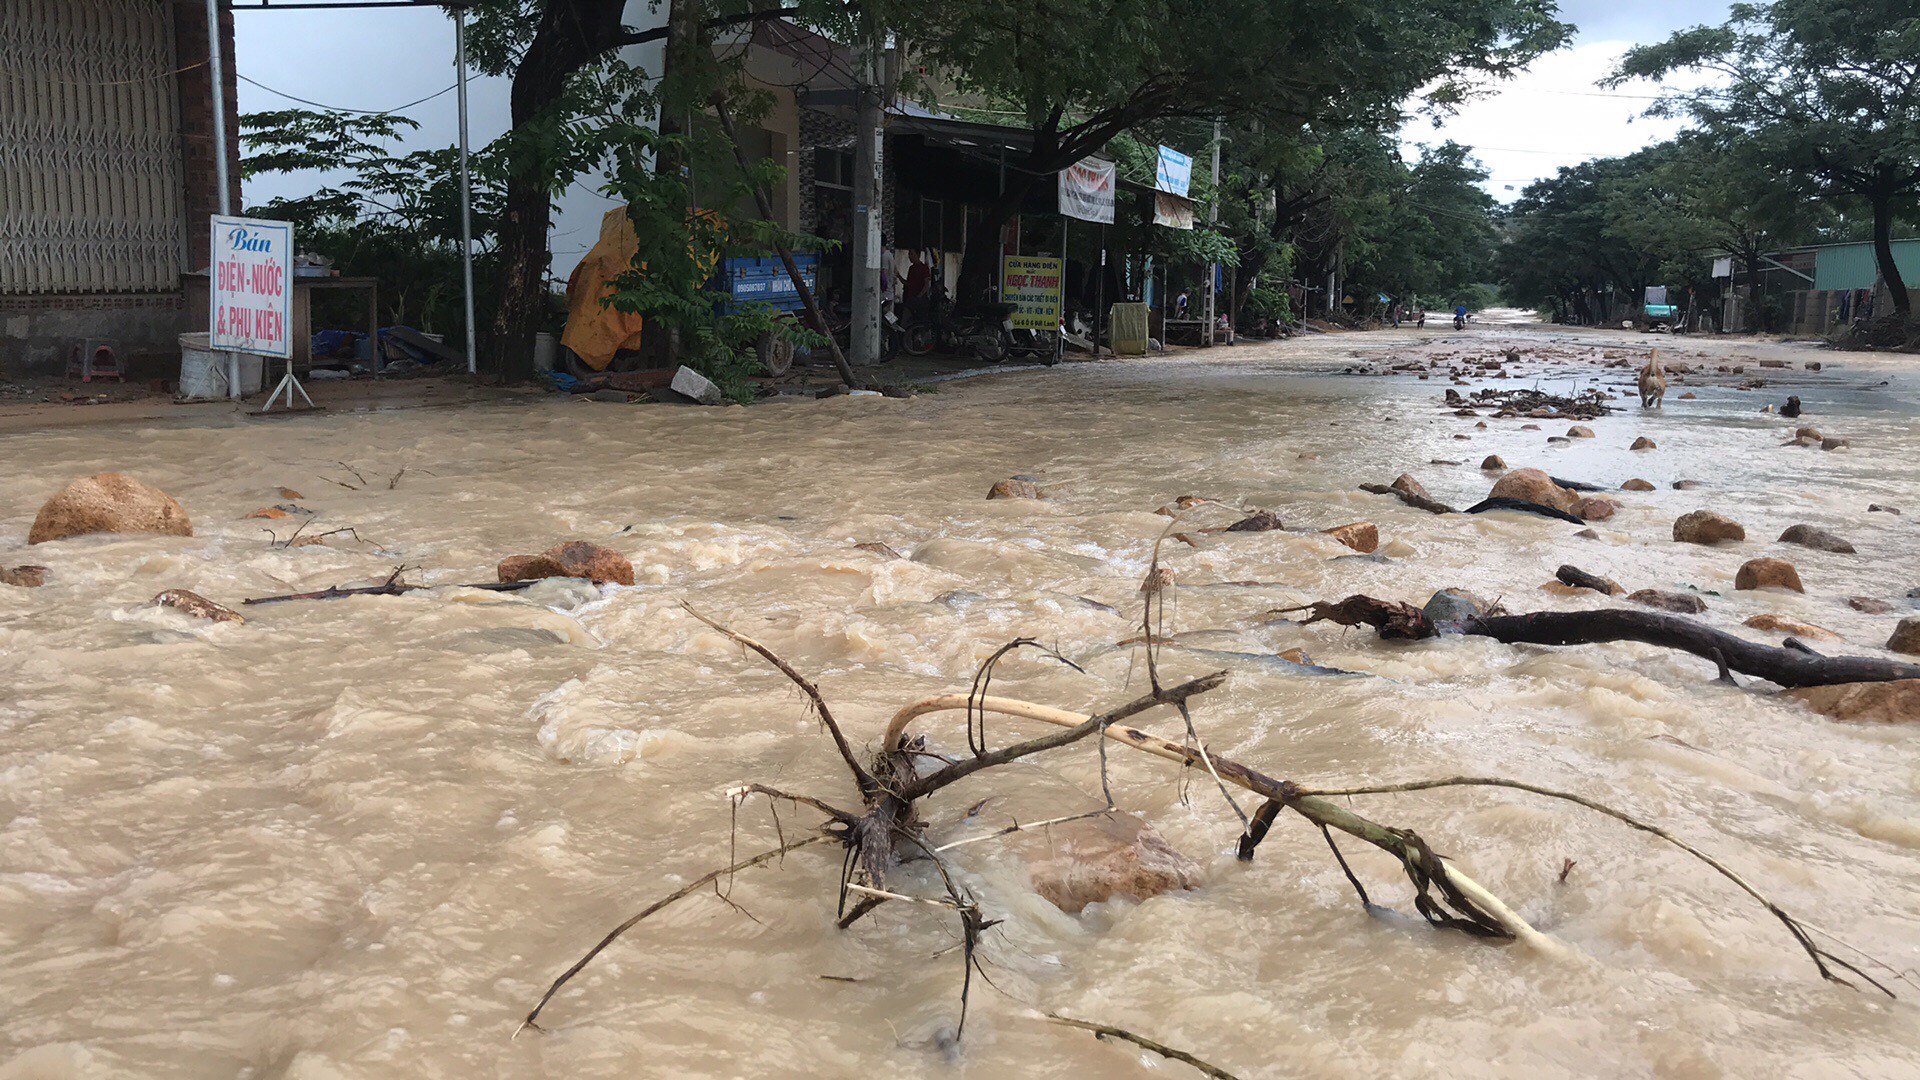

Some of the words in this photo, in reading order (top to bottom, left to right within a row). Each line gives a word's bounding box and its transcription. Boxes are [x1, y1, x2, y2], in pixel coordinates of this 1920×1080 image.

[229, 228, 272, 252] Bán
[1007, 274, 1028, 290] NGỌC
[217, 305, 226, 335] &
[229, 306, 251, 344] PHỤ
[255, 302, 283, 346] KIỆN
